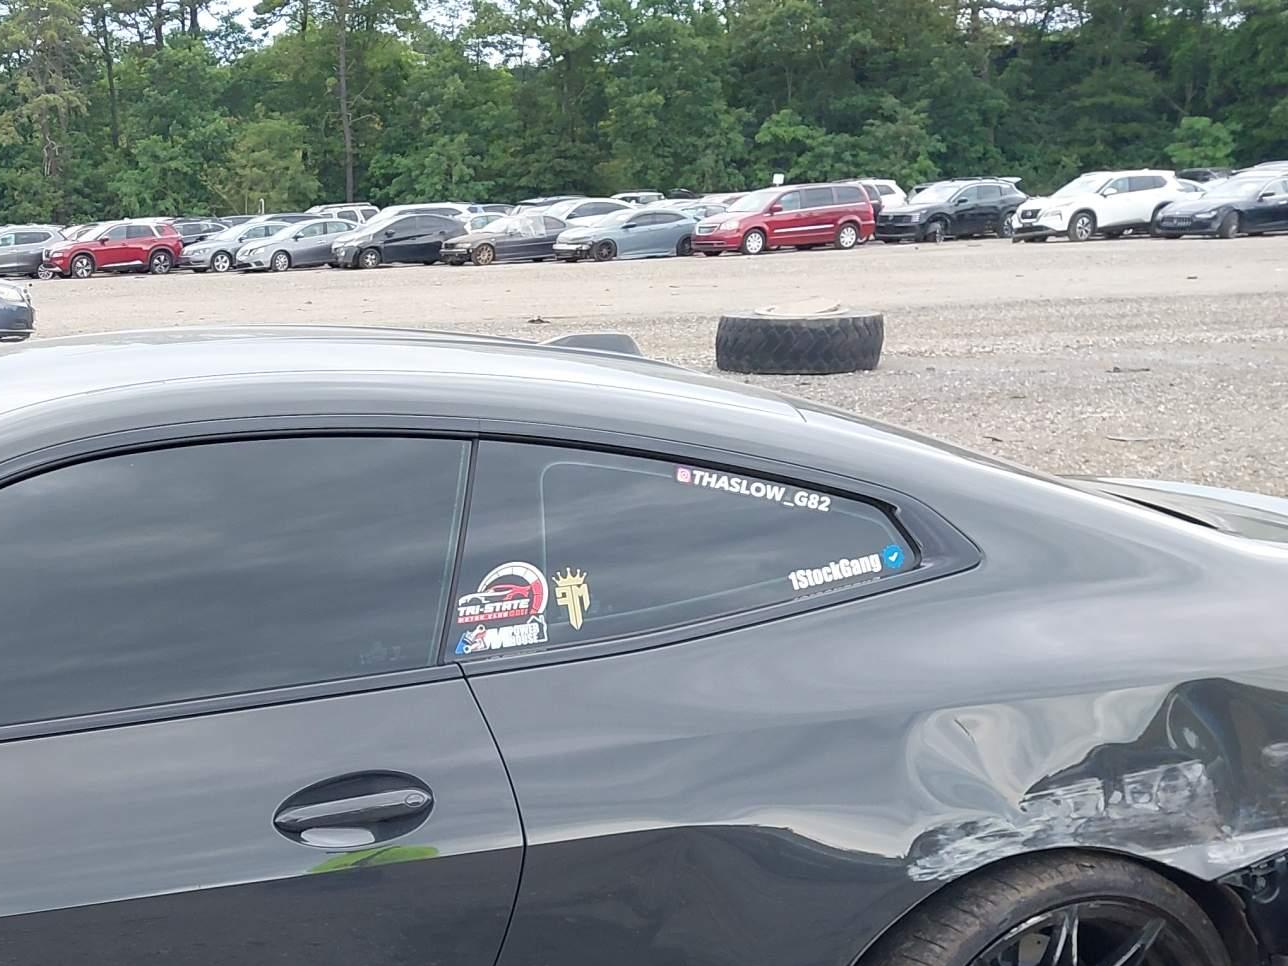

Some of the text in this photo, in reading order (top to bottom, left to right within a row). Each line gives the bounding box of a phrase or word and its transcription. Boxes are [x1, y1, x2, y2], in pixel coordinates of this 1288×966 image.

[692, 470, 831, 512] THASLOW_G82
[788, 553, 883, 591] 1StockGang
[457, 599, 531, 617] TRI-STATE
